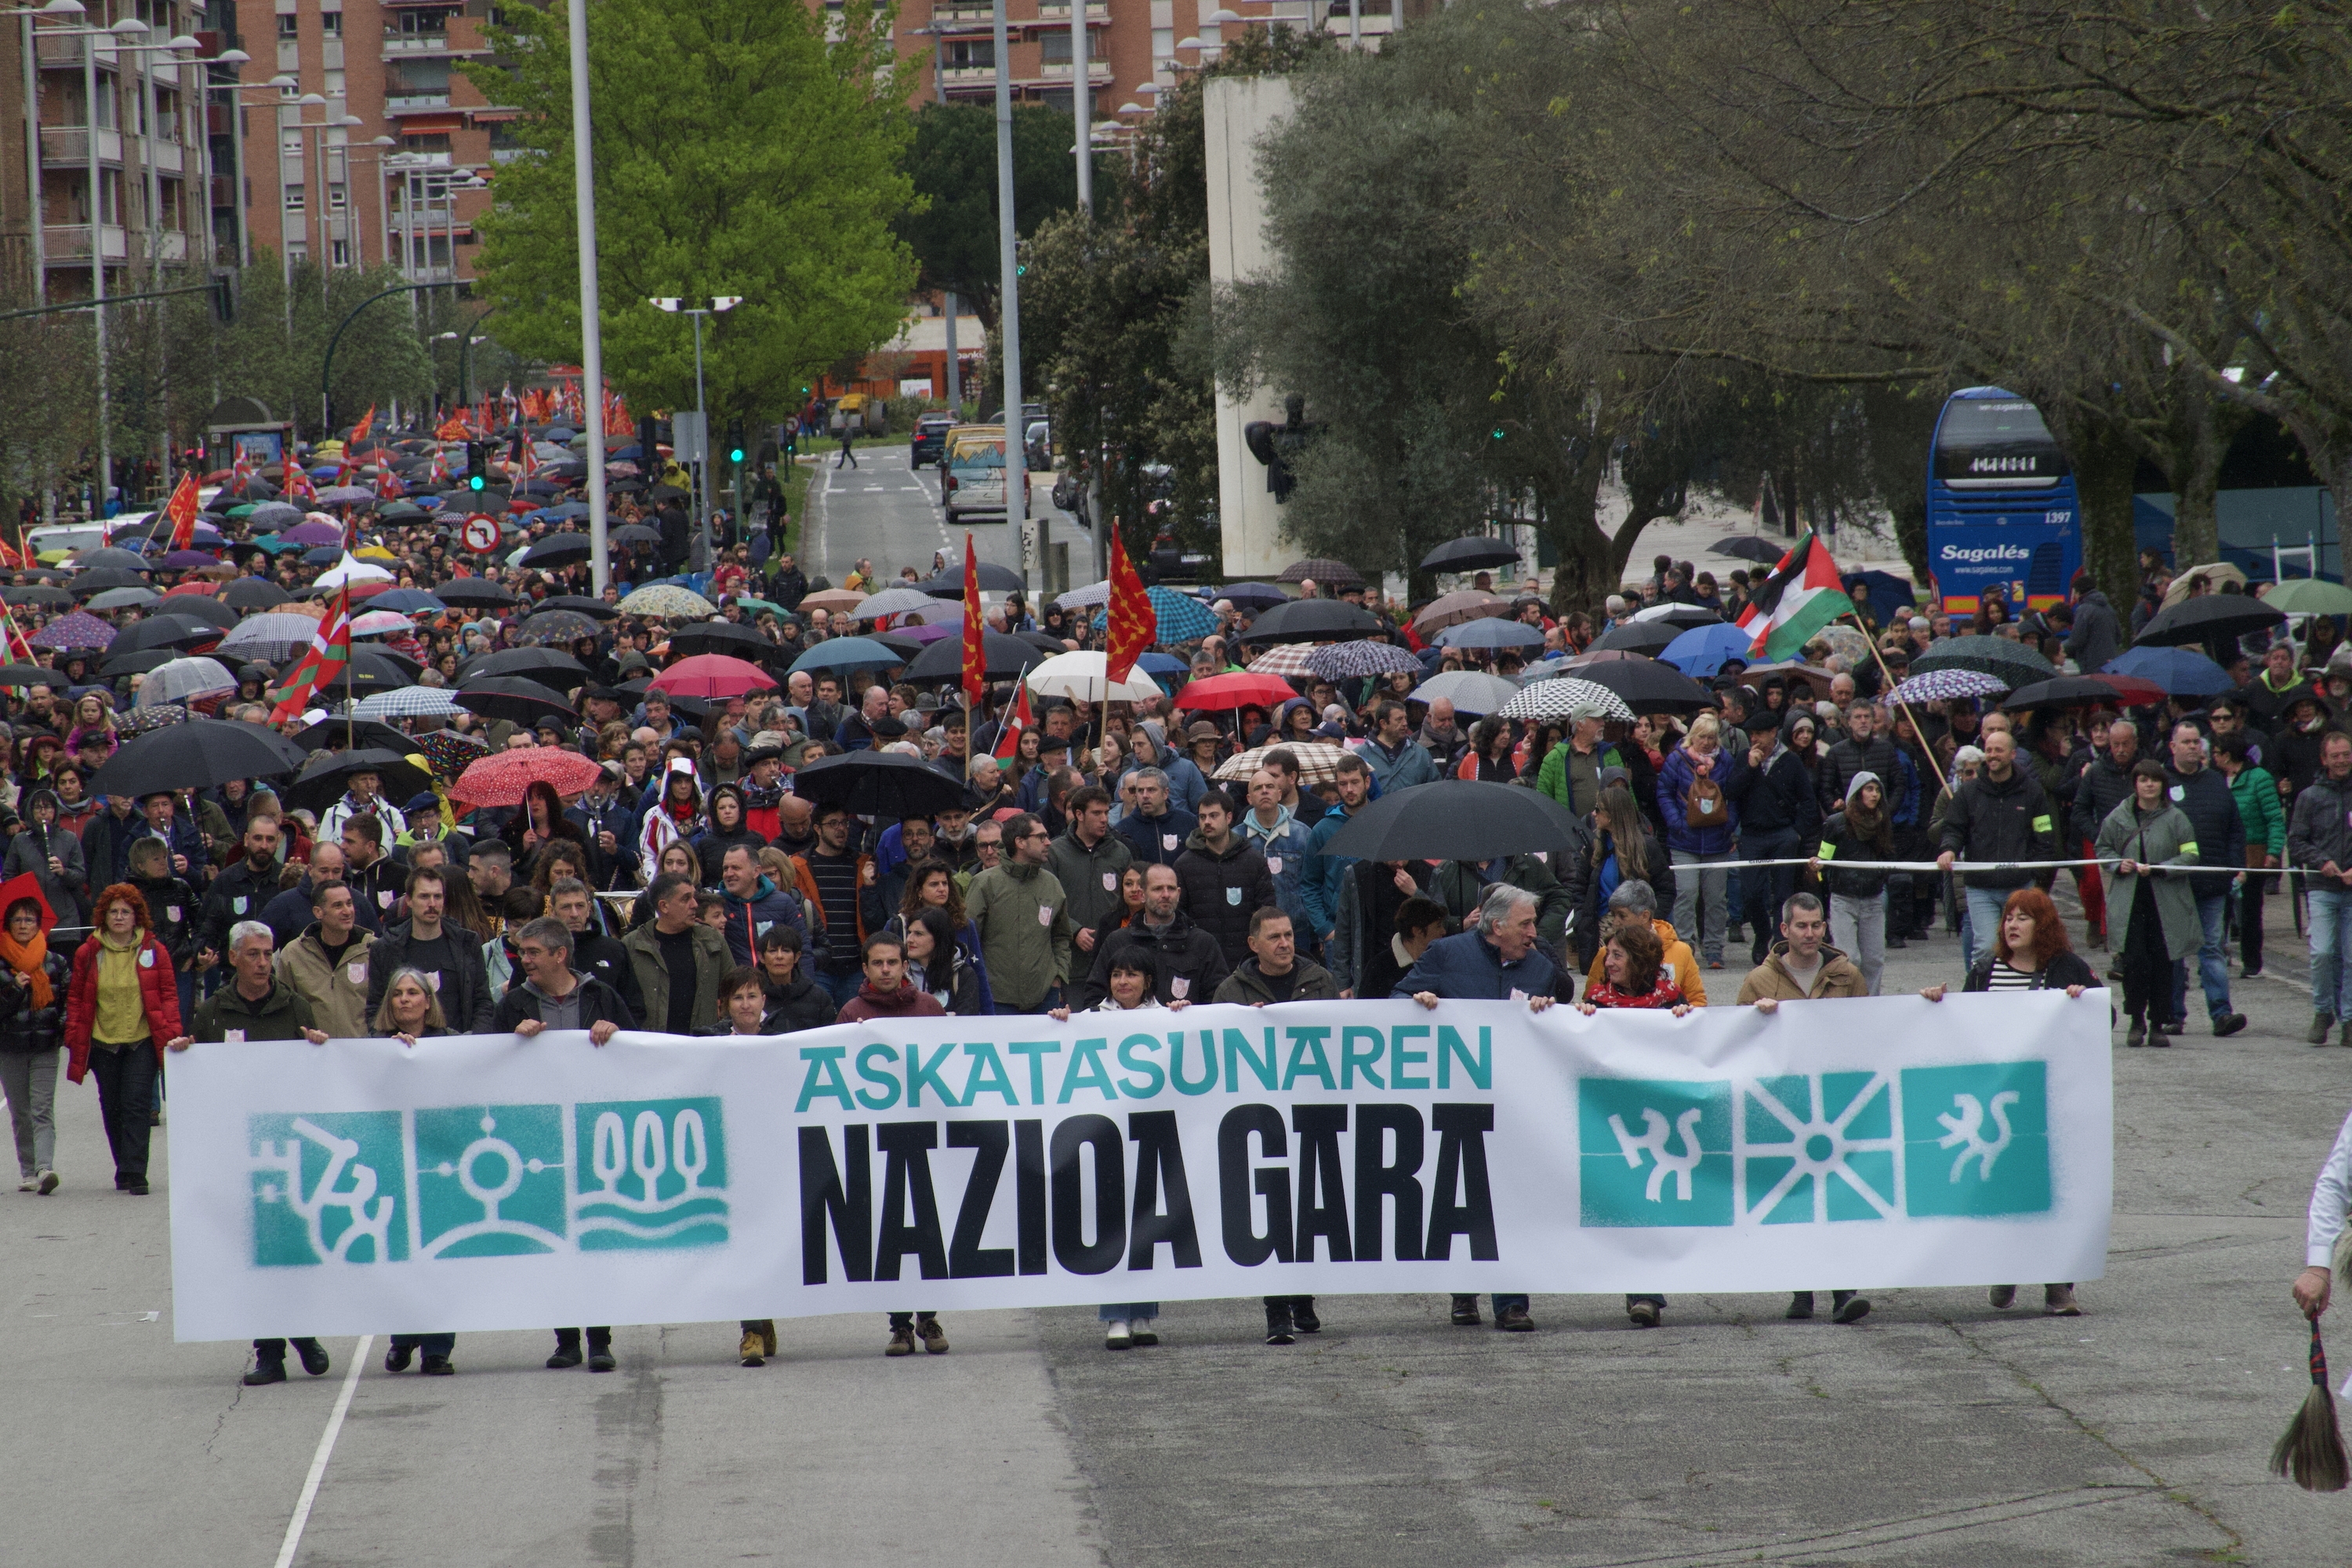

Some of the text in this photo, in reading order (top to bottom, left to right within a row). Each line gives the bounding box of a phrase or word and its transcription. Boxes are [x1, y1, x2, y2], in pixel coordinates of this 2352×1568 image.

[2045, 511, 2071, 524] 1397
[1940, 543, 2030, 562] Sagalés
[795, 1025, 1492, 1113] ASKATASUNAREN
[797, 1102, 1499, 1286] NAZIOA GARA
